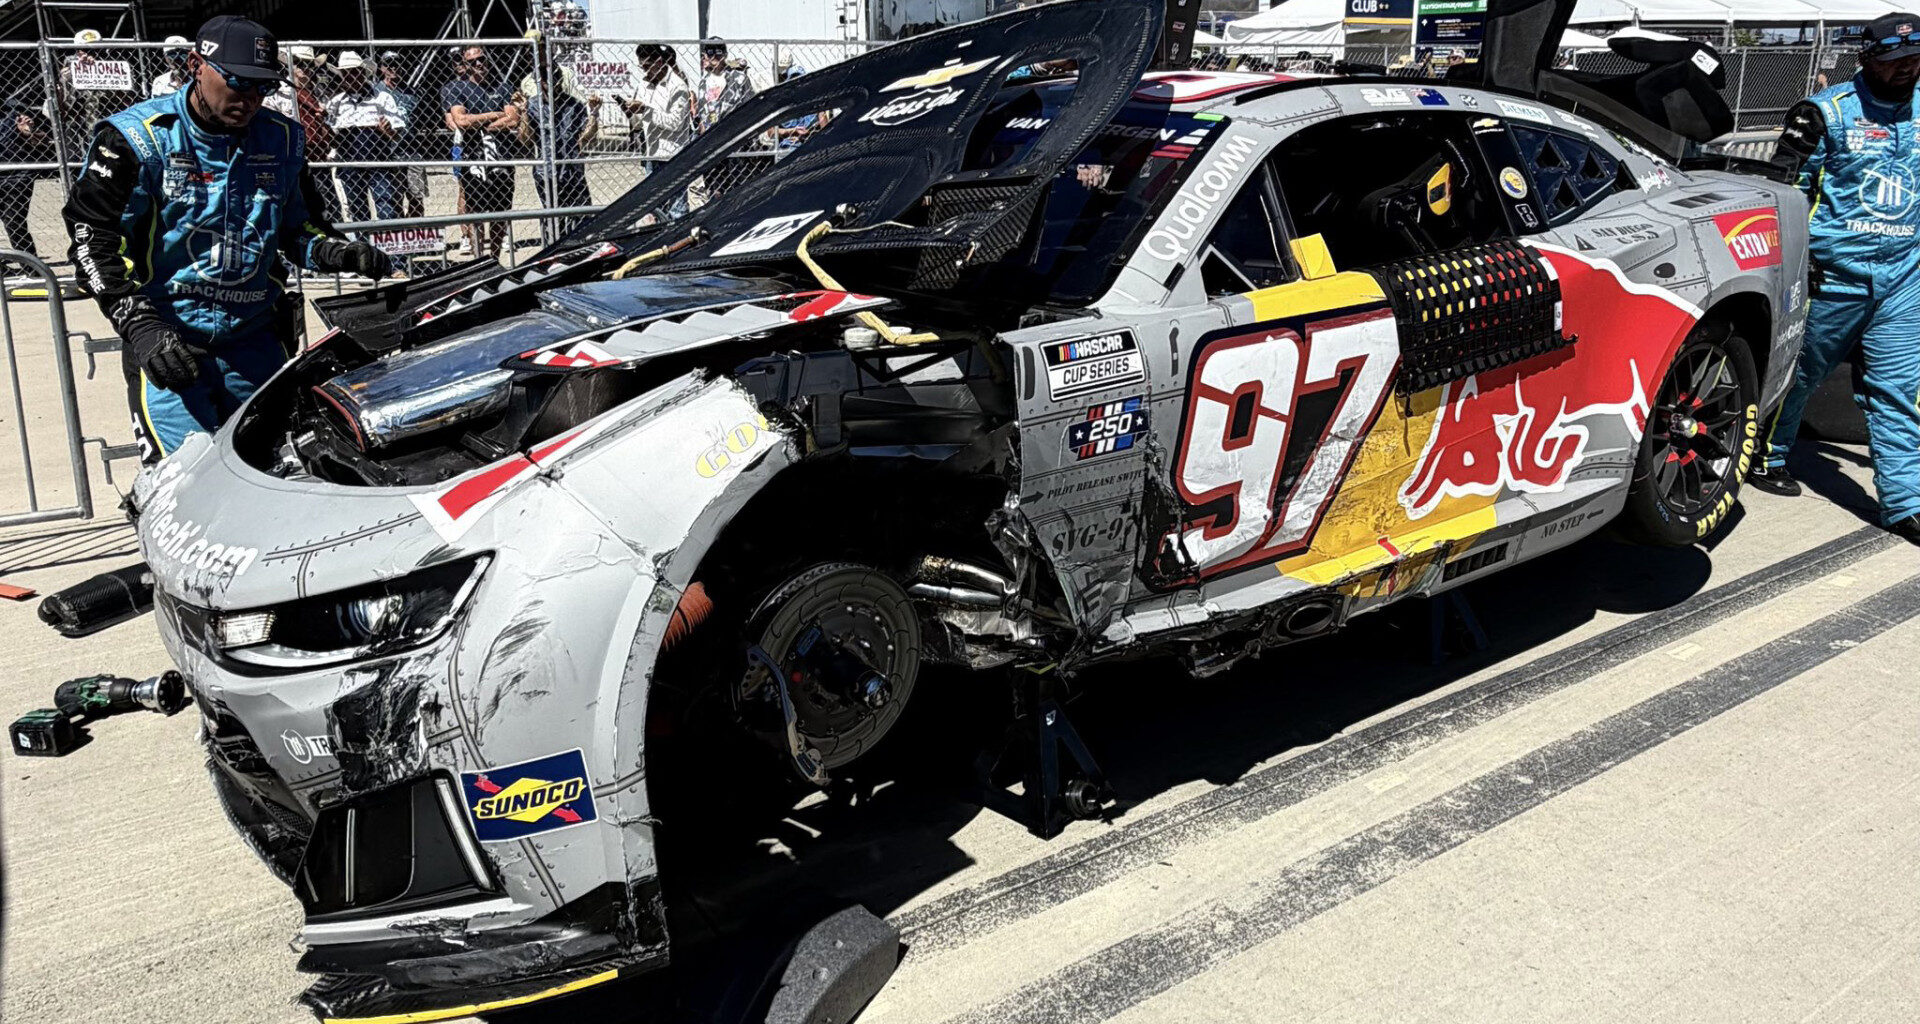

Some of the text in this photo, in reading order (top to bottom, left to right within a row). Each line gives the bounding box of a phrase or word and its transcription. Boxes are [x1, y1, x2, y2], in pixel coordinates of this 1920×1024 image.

[1352, 0, 1377, 12] CLUB
[201, 41, 219, 56] 97
[74, 62, 127, 75] NATIONAL
[1005, 117, 1050, 129] VAN
[1142, 134, 1259, 261] Qualcomm
[374, 228, 443, 243] NATIONAL
[1591, 227, 1617, 238] SAN
[170, 280, 268, 302] TRACKHOUSE
[1076, 335, 1124, 359] NASCAR
[1063, 357, 1130, 385] CUP SERIES
[1088, 413, 1133, 442] 250
[1158, 312, 1400, 586] 97
[1047, 485, 1075, 499] PILOT
[1076, 475, 1116, 492] RELEASE
[1541, 513, 1586, 539] NO STEP
[310, 736, 331, 755] TR
[480, 780, 580, 817] SUNOCO
